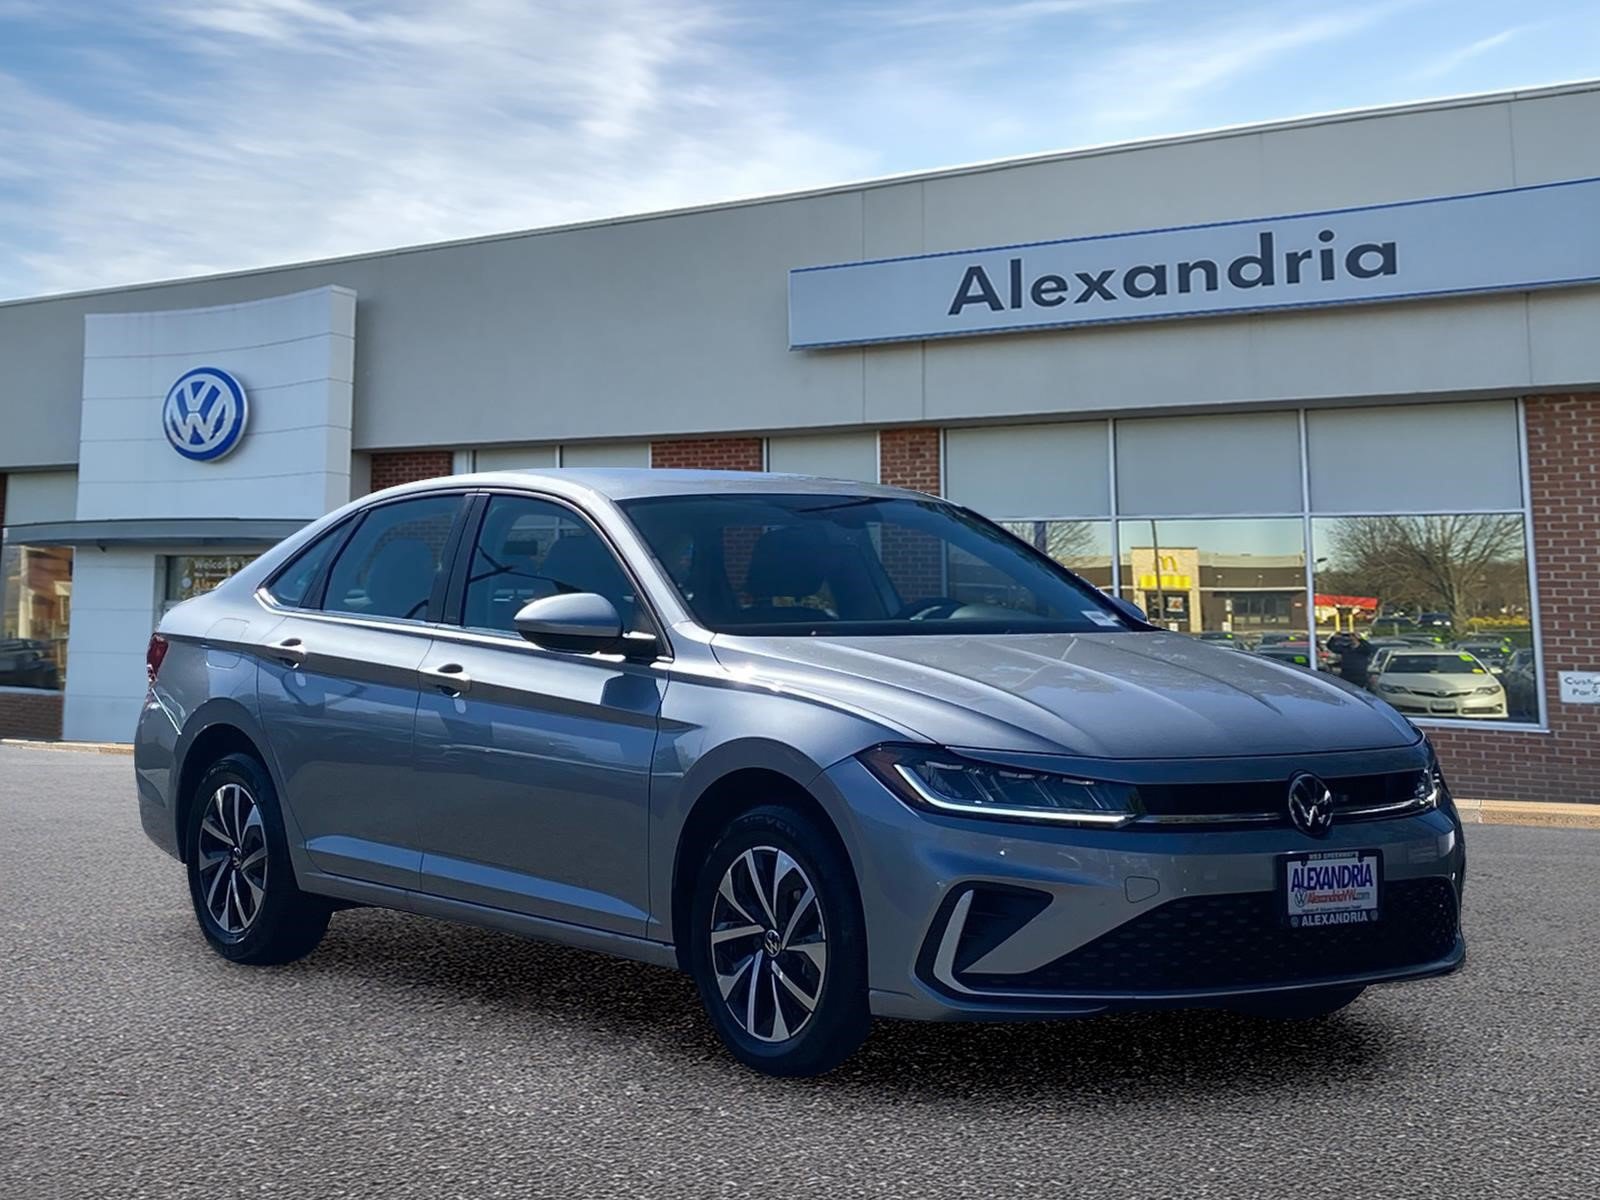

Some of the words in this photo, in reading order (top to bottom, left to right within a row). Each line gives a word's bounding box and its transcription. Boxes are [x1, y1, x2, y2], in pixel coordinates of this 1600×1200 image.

[948, 229, 1398, 316] Alexandria
[165, 373, 238, 453] VW
[1291, 864, 1373, 892] ALEXANDRIA
[1302, 911, 1368, 927] ALEXANDRIA
